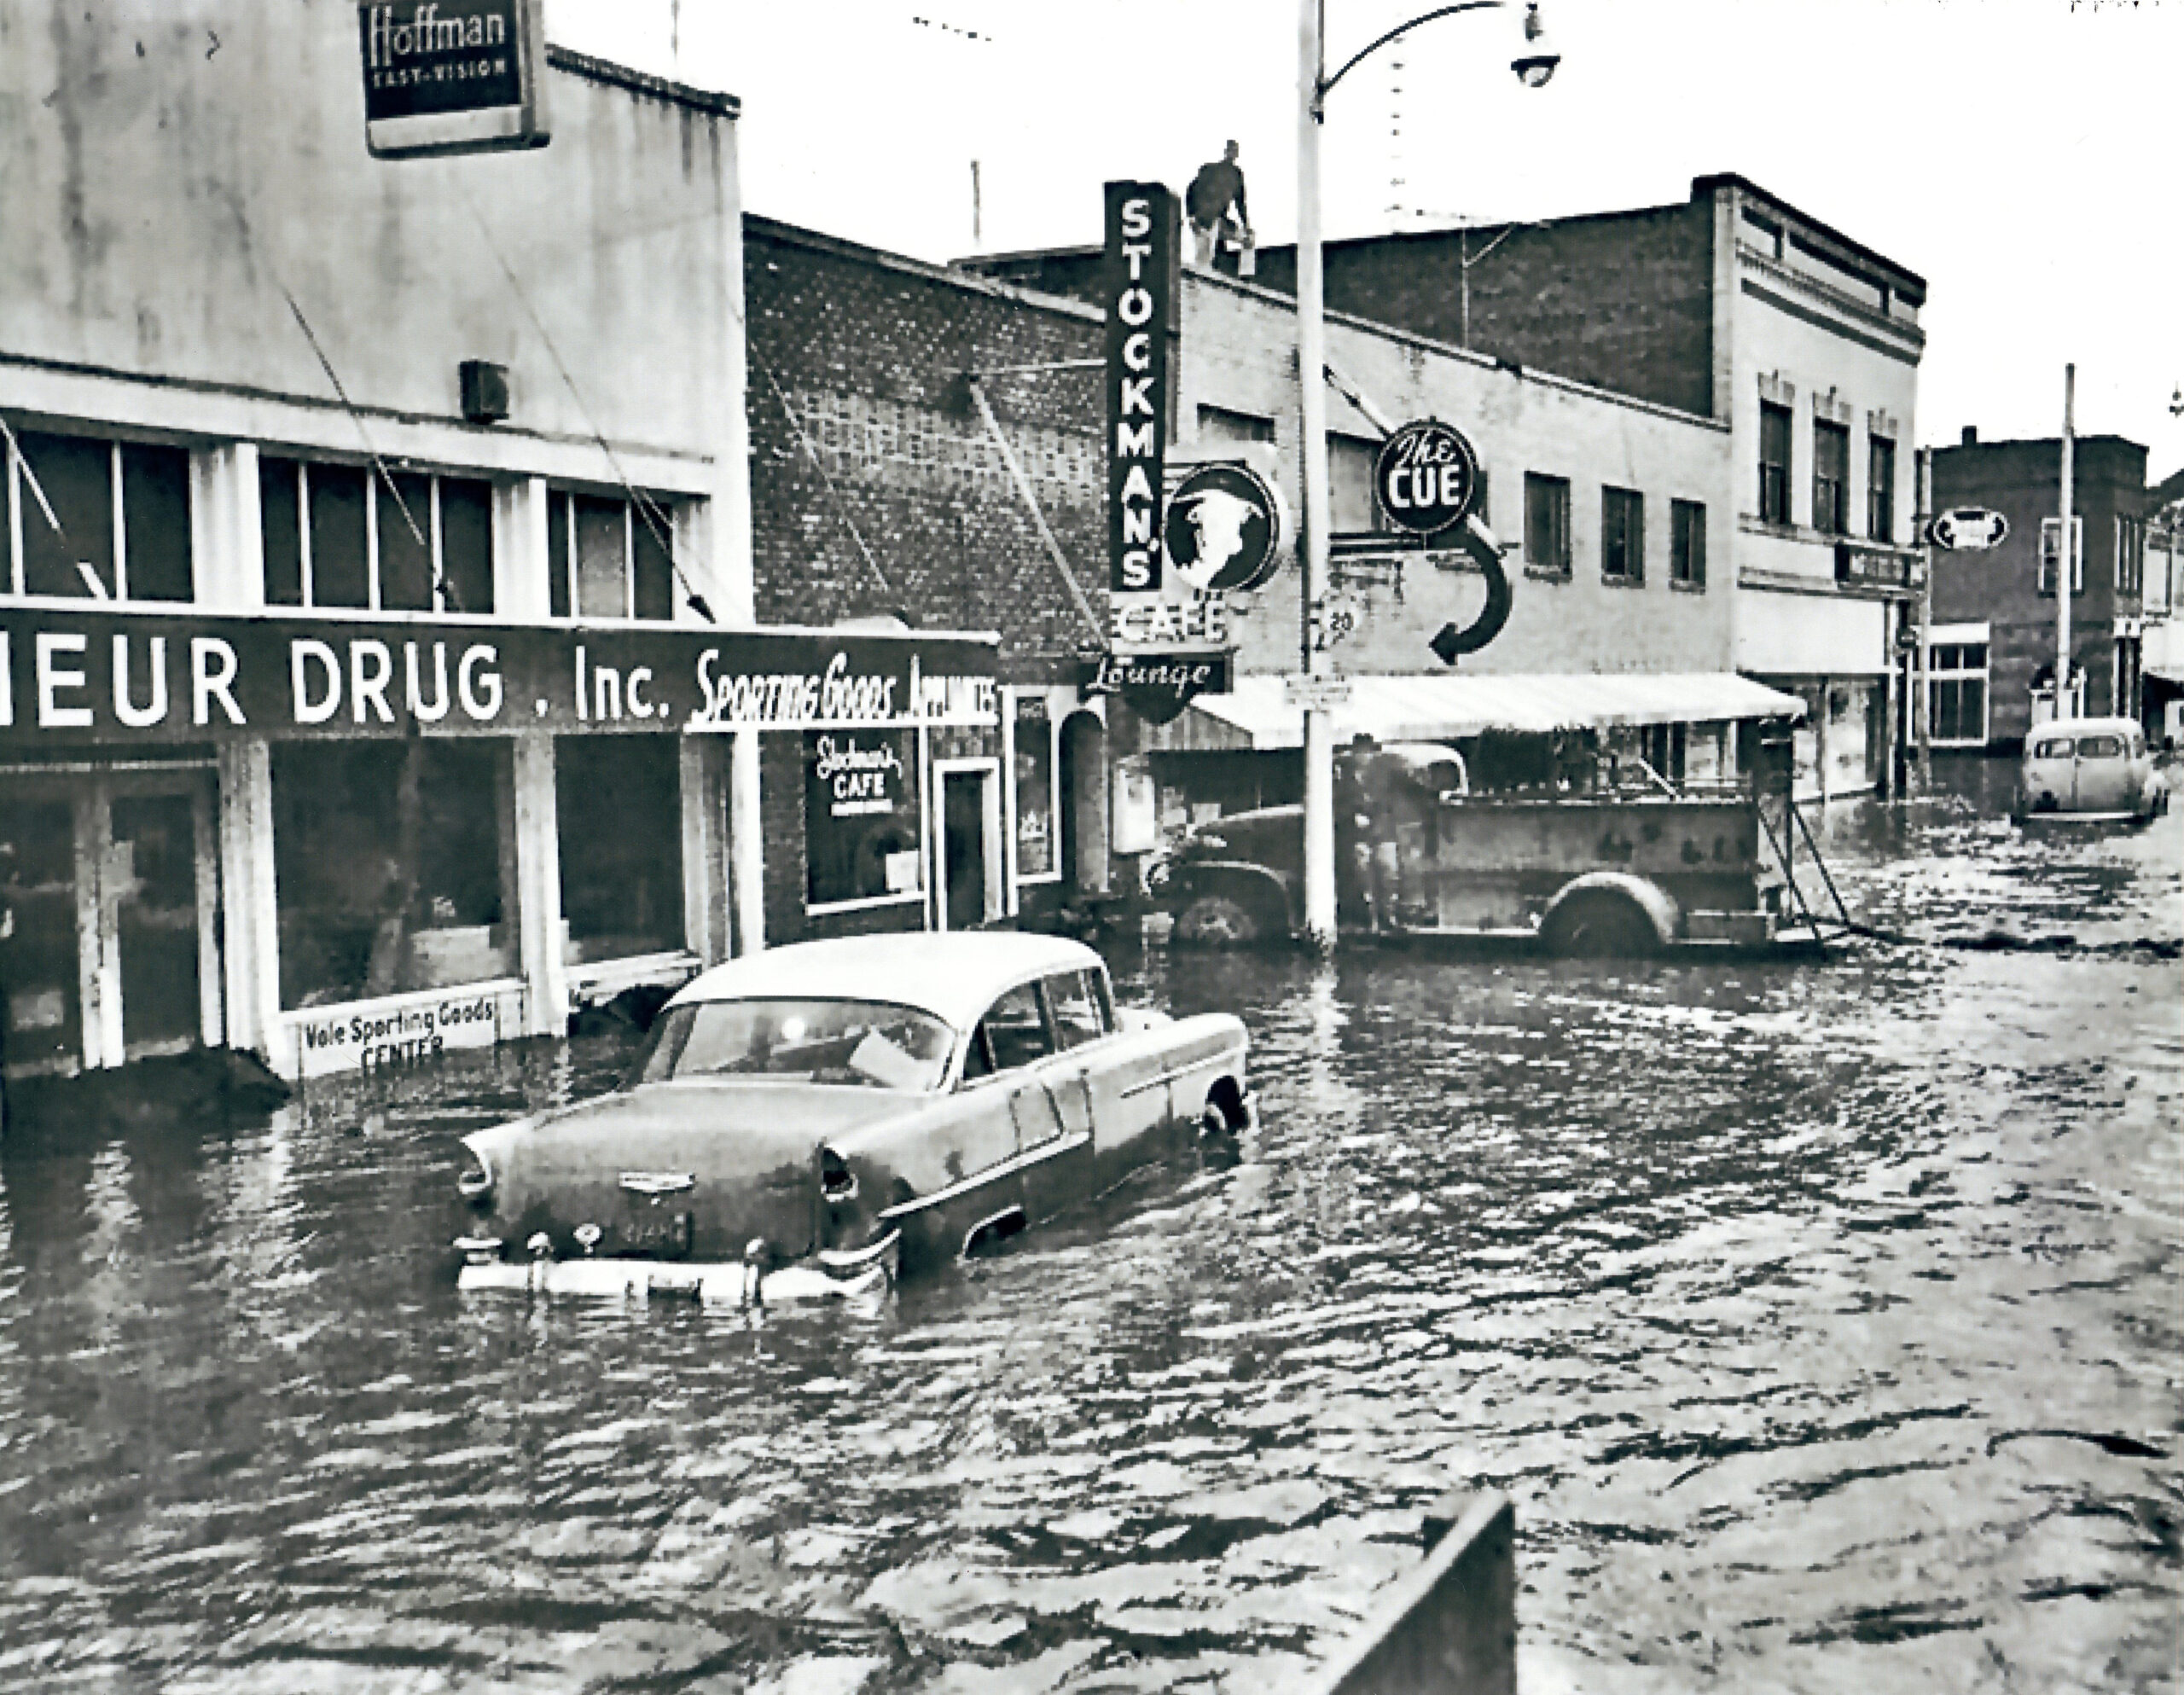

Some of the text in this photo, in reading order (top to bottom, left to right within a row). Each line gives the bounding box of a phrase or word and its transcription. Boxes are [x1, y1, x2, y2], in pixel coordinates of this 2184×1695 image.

[370, 3, 506, 67] Hoffman
[1118, 199, 1159, 586] STOCKMAN'S
[1393, 429, 1457, 469] The
[1388, 463, 1460, 508] CUE
[0, 630, 671, 727] EUR DRUG Inc.
[1084, 656, 1211, 699] Lounge
[834, 772, 885, 799] CAFE
[350, 1013, 435, 1046] Sporting
[439, 996, 493, 1025] Goods
